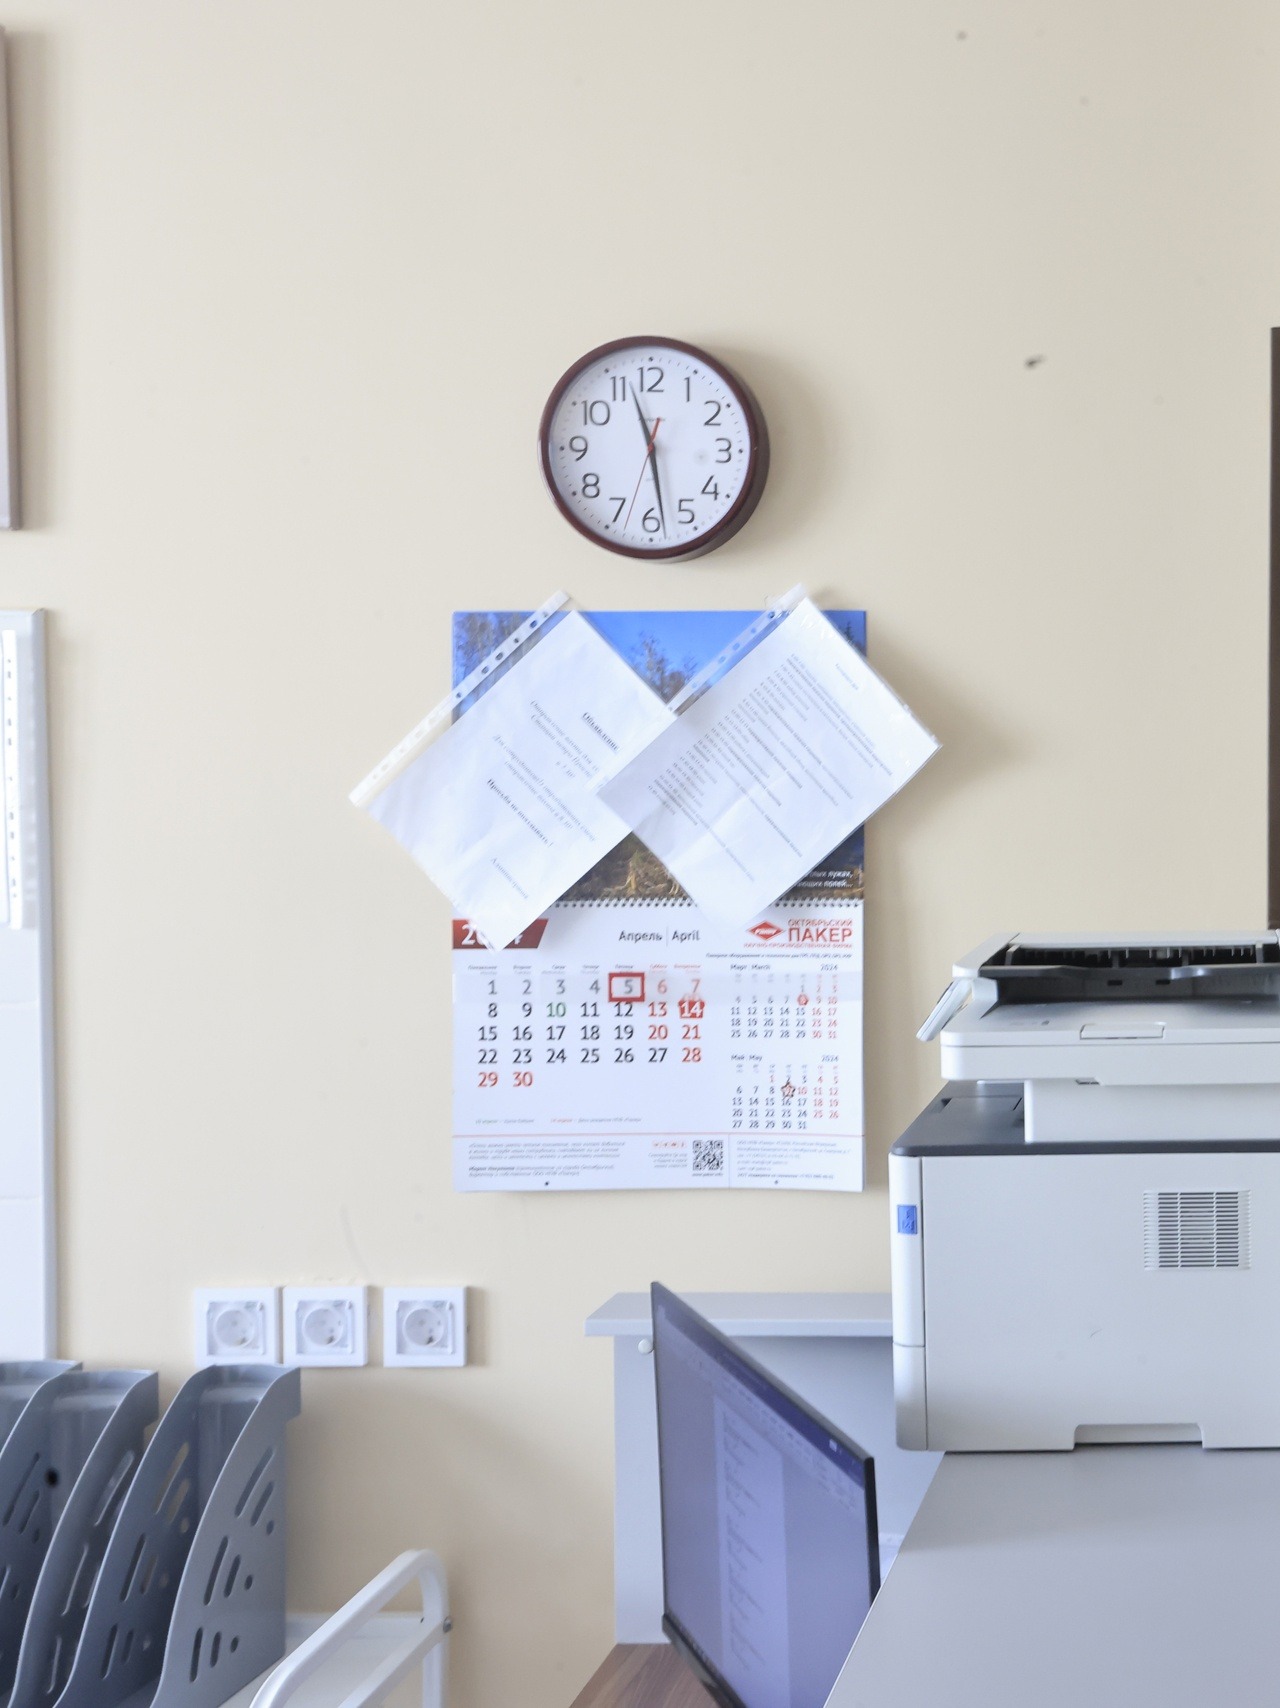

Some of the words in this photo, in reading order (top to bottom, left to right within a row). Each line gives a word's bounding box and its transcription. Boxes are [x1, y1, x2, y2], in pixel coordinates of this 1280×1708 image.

[611, 376, 626, 401] 11
[637, 367, 664, 393] 12
[685, 377, 690, 402] 1
[582, 401, 610, 426] 10
[704, 401, 721, 426] 2
[569, 436, 588, 461] 9
[715, 438, 731, 463] 3
[582, 473, 600, 498] 8
[701, 476, 719, 500] 4
[609, 498, 626, 523] 7
[642, 507, 660, 532] 6
[678, 499, 695, 524] 5
[619, 930, 663, 943] Апрель
[672, 929, 700, 943] April
[788, 928, 852, 942] ПАКЕР
[488, 980, 497, 995] 1
[523, 979, 531, 995] 2
[557, 979, 565, 994] 3
[590, 979, 600, 994] 4
[624, 979, 633, 994] 5
[658, 979, 667, 994] 6
[691, 979, 701, 994] 7
[488, 1003, 497, 1017] 8
[522, 1003, 532, 1017] 9
[547, 1002, 566, 1017] 10
[581, 1002, 599, 1017] 11
[614, 1003, 633, 1017] 12
[648, 1002, 667, 1016] 13
[682, 1003, 702, 1017] 14
[479, 1026, 497, 1041] 15
[513, 1026, 532, 1040] 16
[547, 1026, 565, 1040] 17
[581, 1025, 599, 1040] 18
[615, 1025, 633, 1039] 19
[649, 1025, 668, 1039] 20
[682, 1025, 700, 1039] 21
[479, 1049, 497, 1063] 22
[513, 1049, 532, 1063] 23
[547, 1049, 566, 1063] 24
[581, 1048, 599, 1063] 25
[615, 1048, 634, 1062] 26
[649, 1048, 667, 1062] 27
[682, 1048, 701, 1062] 28
[478, 1072, 498, 1087] 29
[514, 1072, 532, 1086] 30
